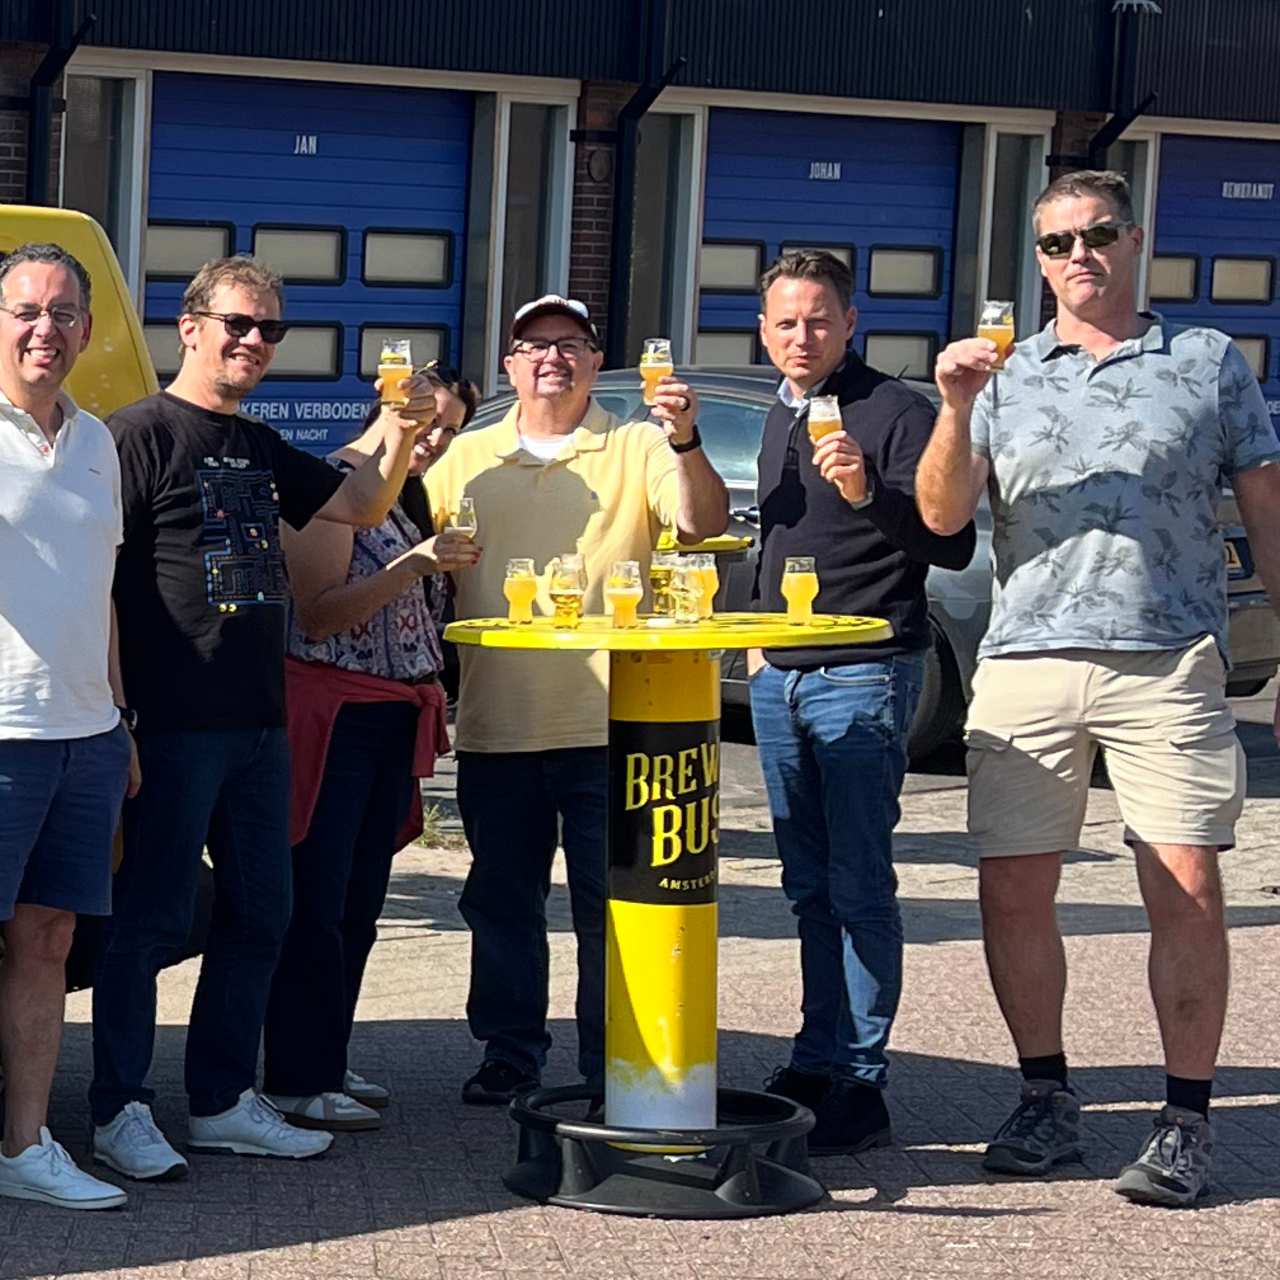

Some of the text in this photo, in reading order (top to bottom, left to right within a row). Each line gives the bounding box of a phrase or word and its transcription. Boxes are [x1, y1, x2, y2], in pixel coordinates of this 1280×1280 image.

[294, 135, 317, 155] JAN
[809, 161, 841, 180] JOHAN
[241, 402, 370, 419] KEREN VERBODEN
[296, 429, 328, 440] NACHT
[625, 742, 720, 811] BREW
